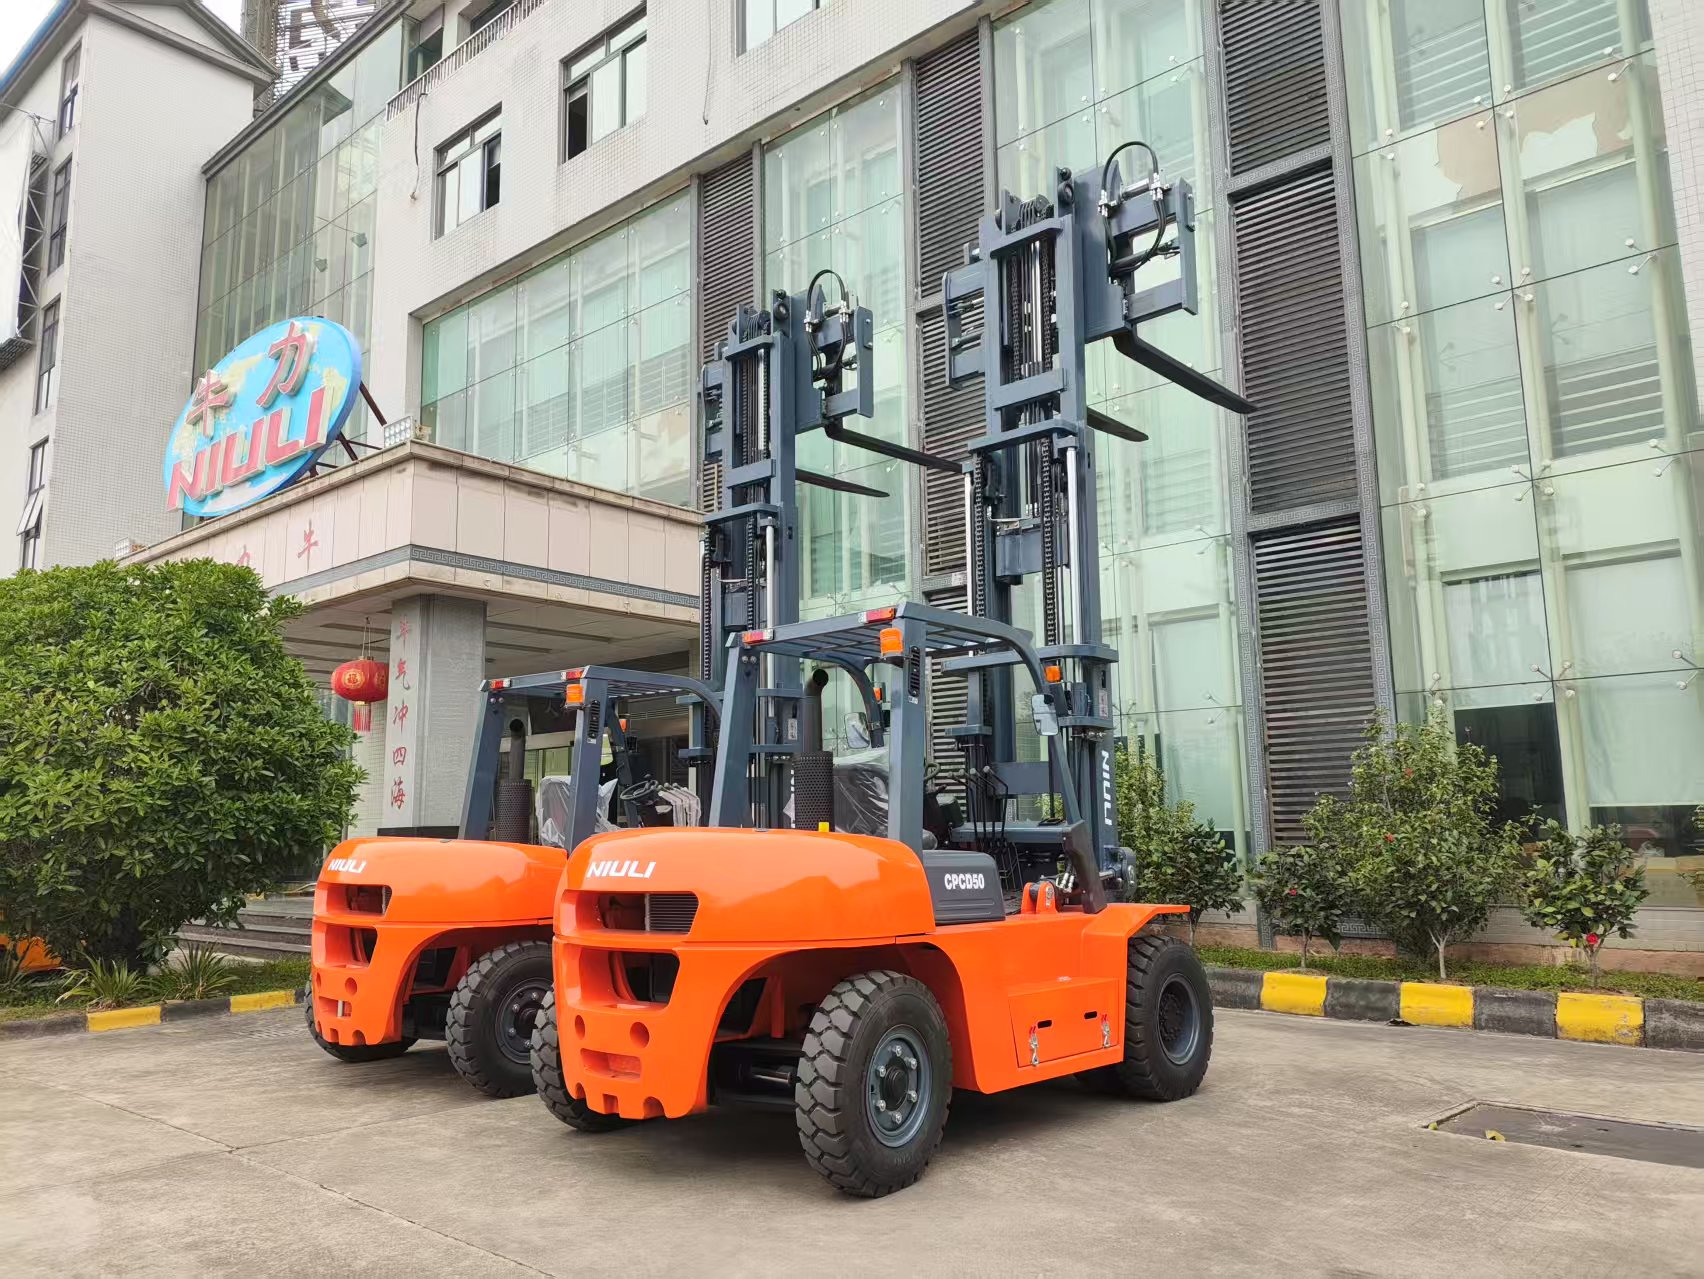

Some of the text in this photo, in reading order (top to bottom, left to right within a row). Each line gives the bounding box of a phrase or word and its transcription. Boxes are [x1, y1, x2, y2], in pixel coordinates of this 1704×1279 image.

[186, 321, 313, 438] 牛力
[166, 385, 331, 511] NIULI
[1101, 750, 1112, 826] NIULI
[328, 859, 367, 873] NIULI
[586, 860, 656, 878] NIULI
[944, 873, 985, 890] CPCD50
